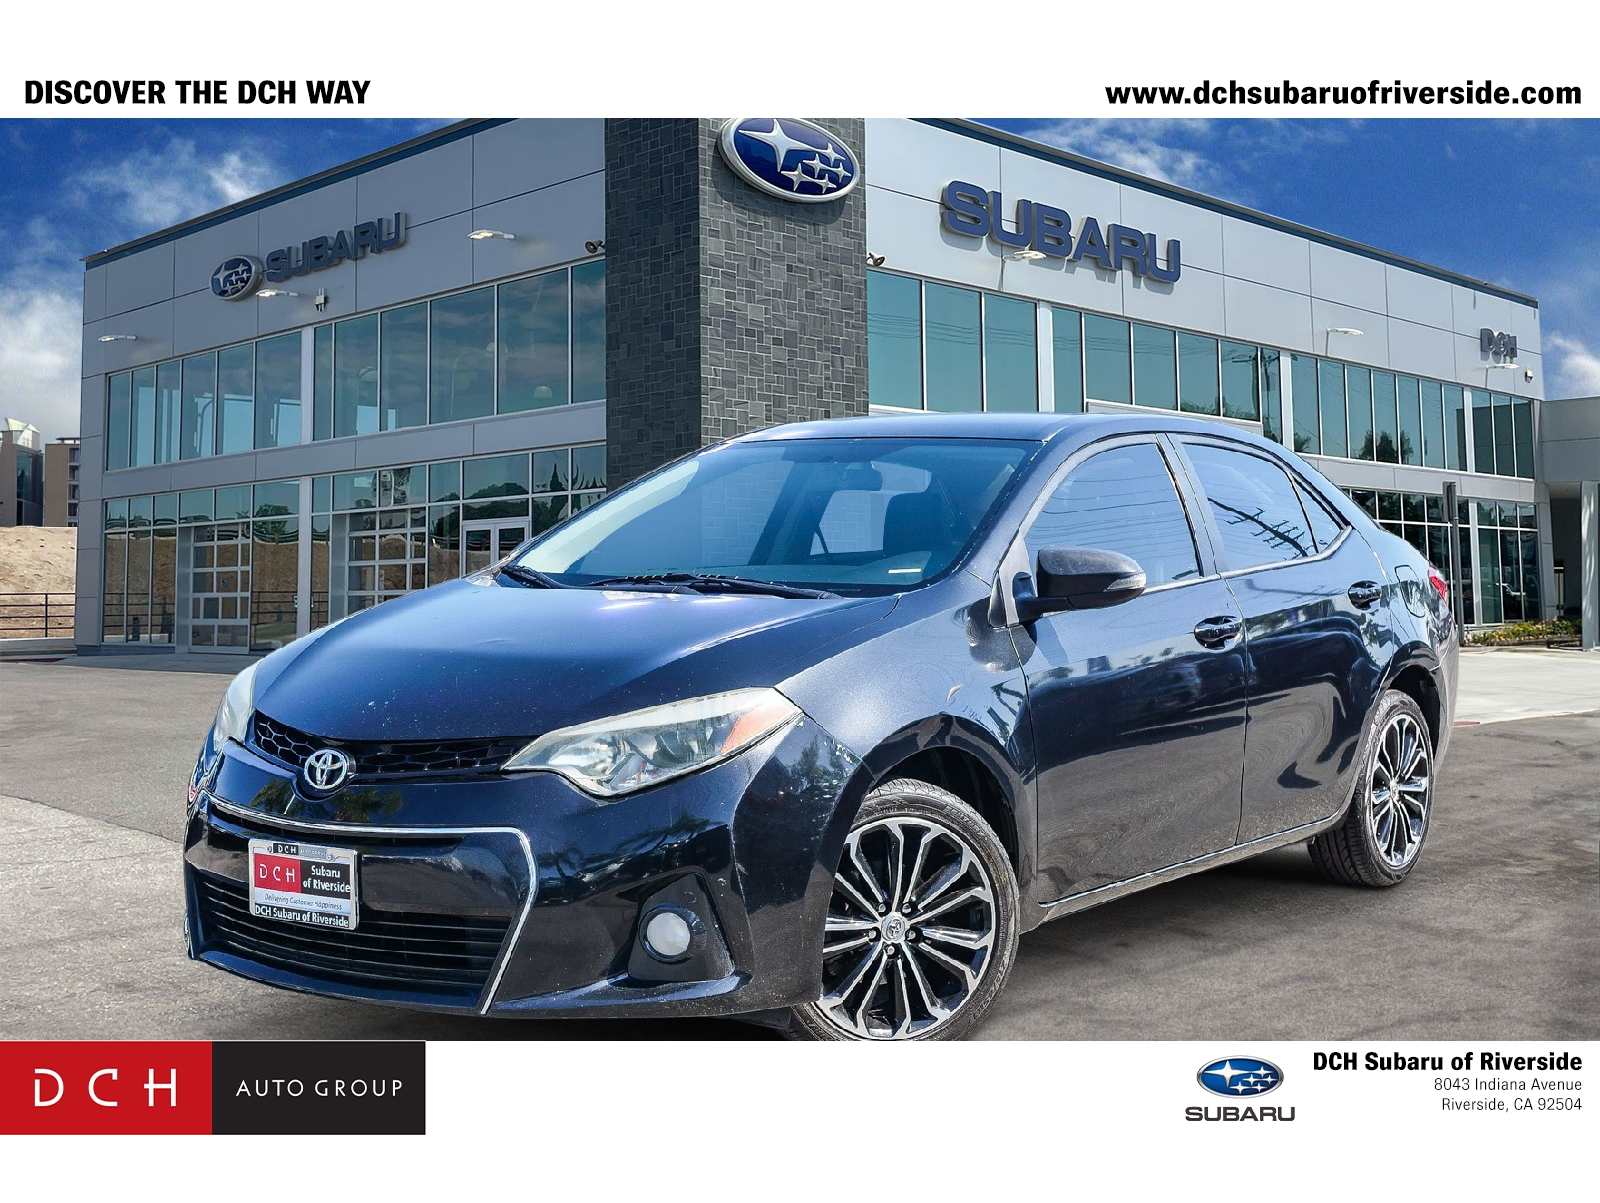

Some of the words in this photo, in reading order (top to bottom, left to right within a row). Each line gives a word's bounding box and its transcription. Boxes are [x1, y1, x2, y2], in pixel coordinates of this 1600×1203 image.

[942, 179, 1181, 284] SUBARU
[266, 211, 407, 283] SUBARU
[277, 844, 297, 854] DCH
[259, 864, 295, 883] DCH
[311, 865, 341, 878] Subaru
[303, 879, 312, 888] of
[312, 879, 351, 893] Riverside
[255, 904, 272, 916] DCH
[273, 907, 301, 921] Subaru
[302, 912, 311, 922] of
[311, 912, 349, 928] Riverside
